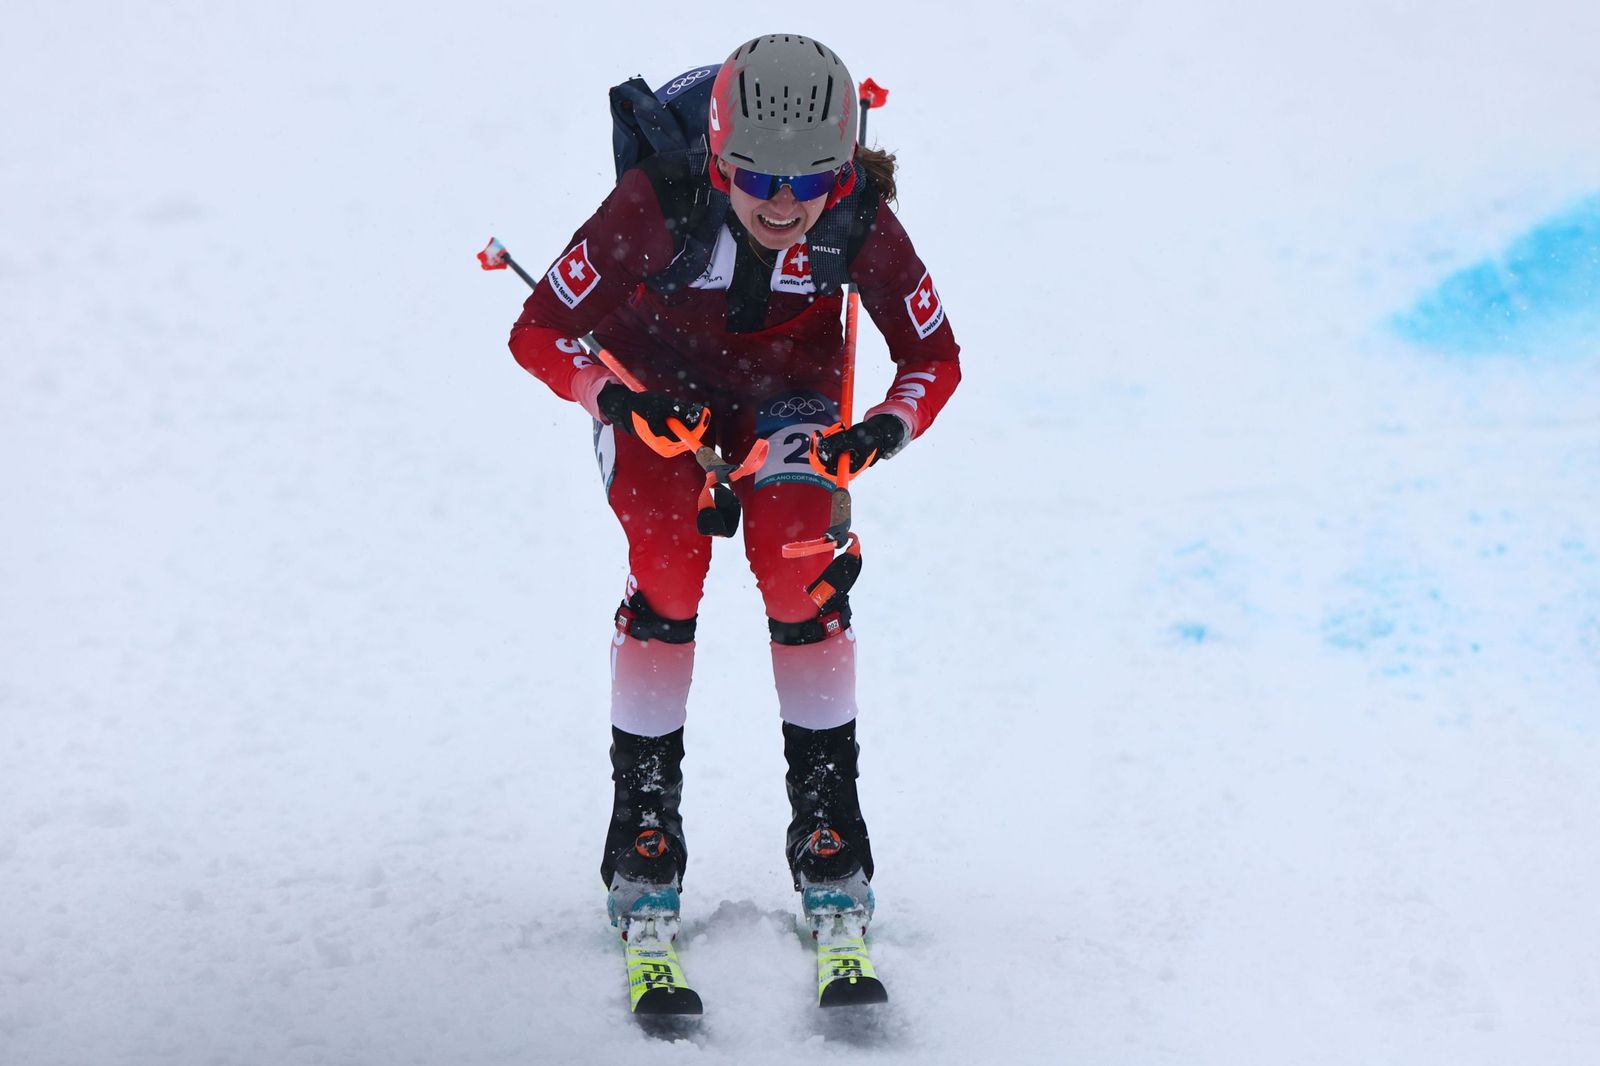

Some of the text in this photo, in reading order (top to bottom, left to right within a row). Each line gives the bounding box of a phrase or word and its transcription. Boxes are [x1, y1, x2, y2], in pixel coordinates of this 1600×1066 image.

[812, 245, 841, 255] MILLET
[779, 278, 800, 286] swiss
[550, 271, 574, 305] swiss team
[783, 432, 811, 465] 2
[827, 621, 838, 630] 002
